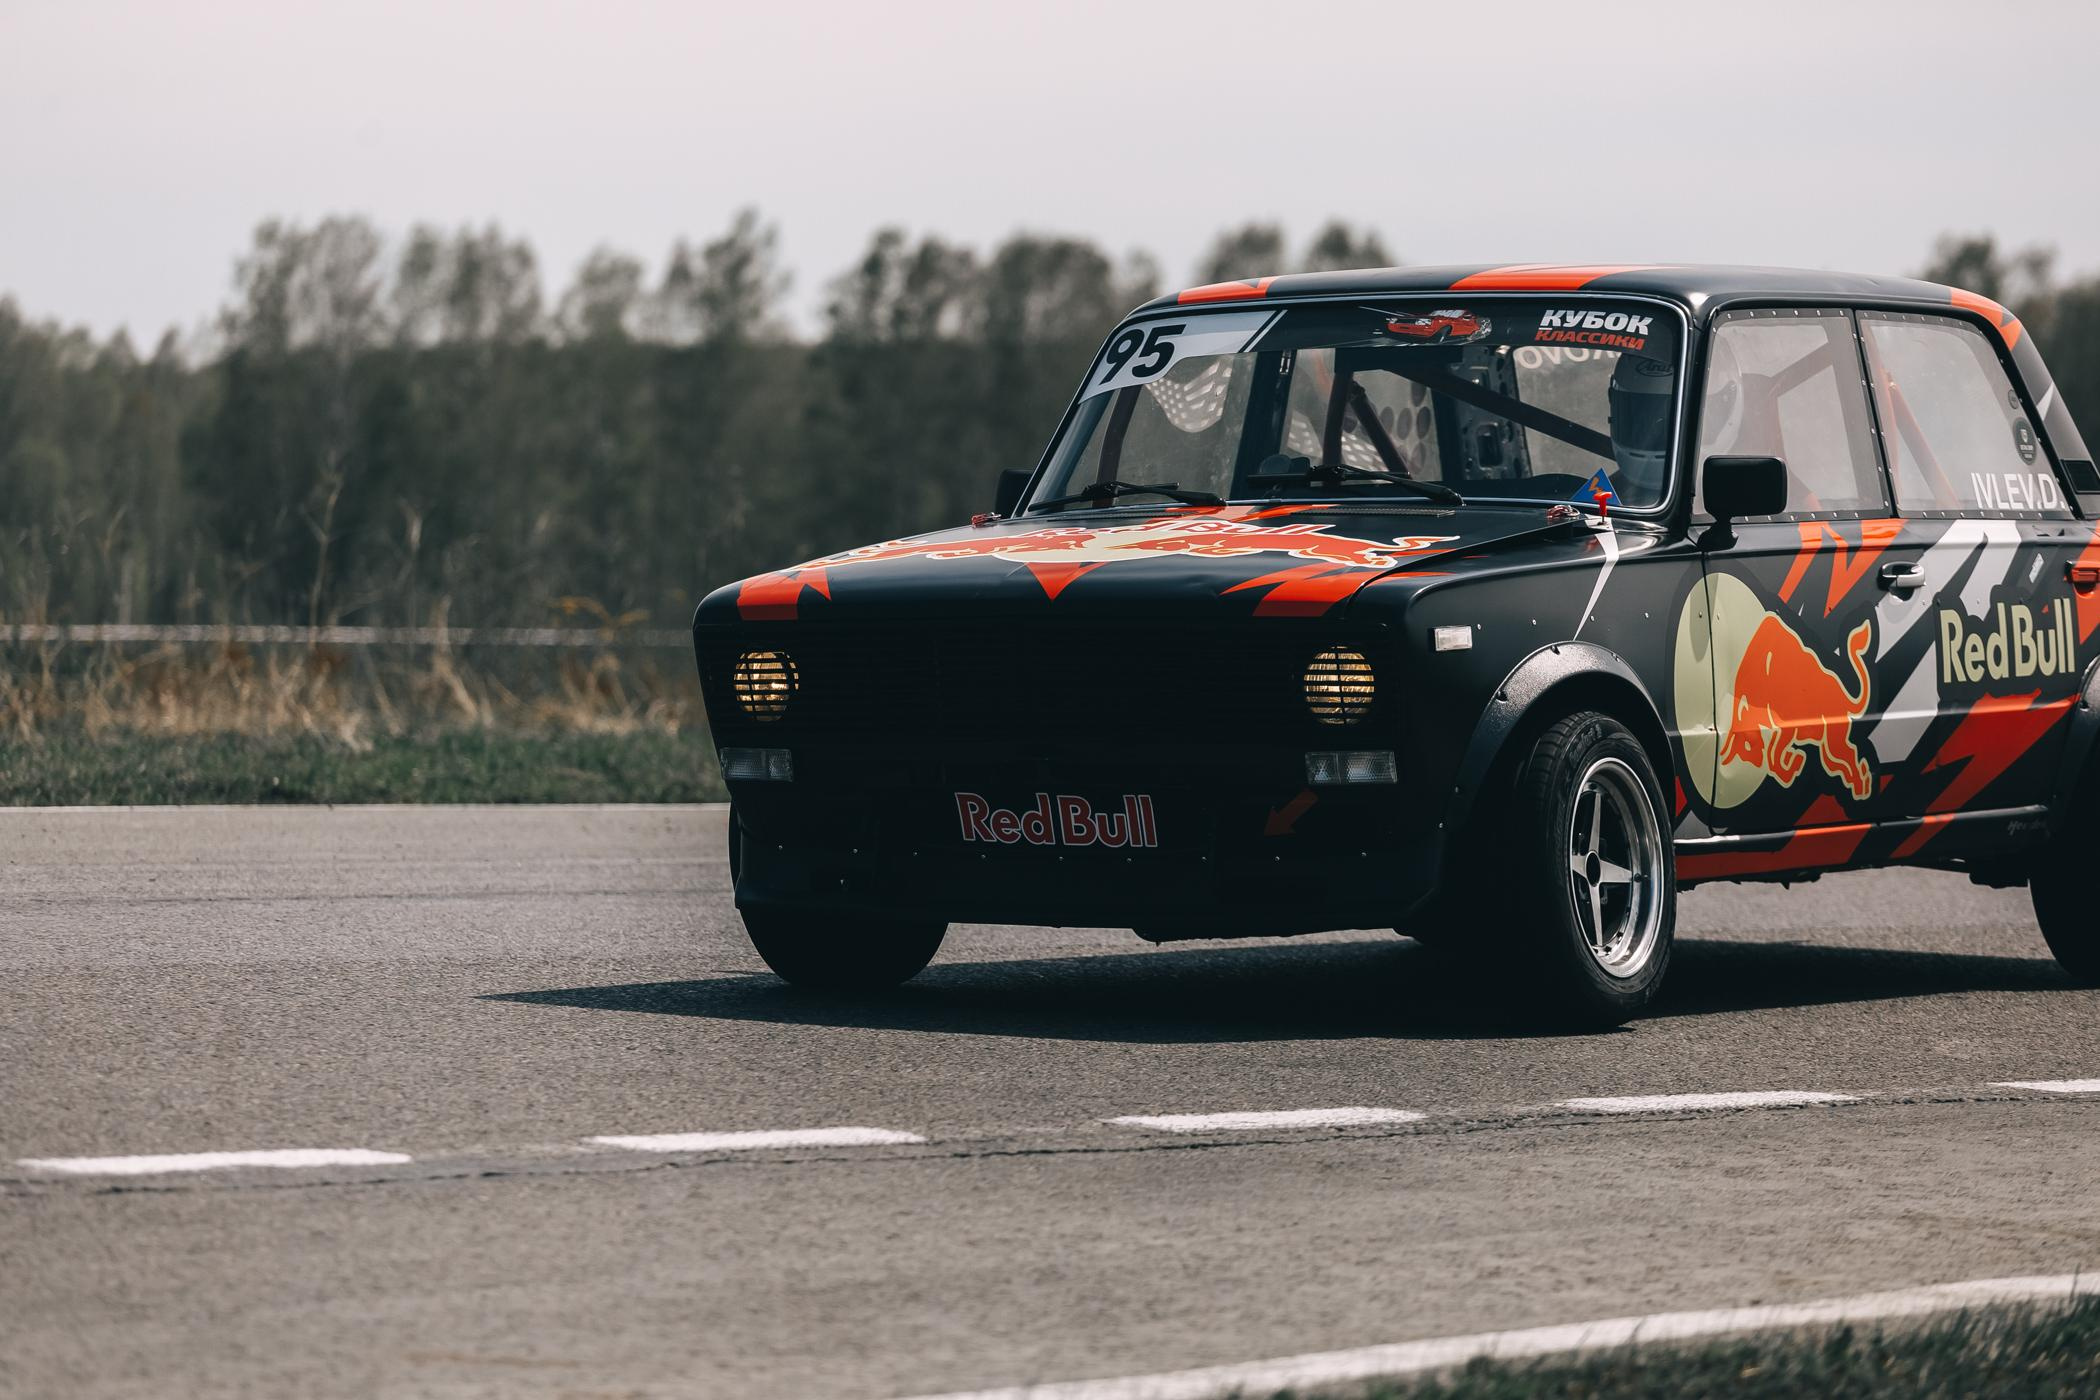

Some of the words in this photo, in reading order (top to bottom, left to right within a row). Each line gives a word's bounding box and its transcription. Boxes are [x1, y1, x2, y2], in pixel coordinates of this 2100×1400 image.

[1535, 329, 1646, 351] КЛАССИКИ
[1540, 309, 1654, 336] КУБОК
[1099, 324, 1187, 385] 95
[1939, 602, 2010, 684] Red
[2011, 597, 2076, 678] Bull
[954, 792, 1056, 845] Red
[1056, 794, 1158, 848] Bull
